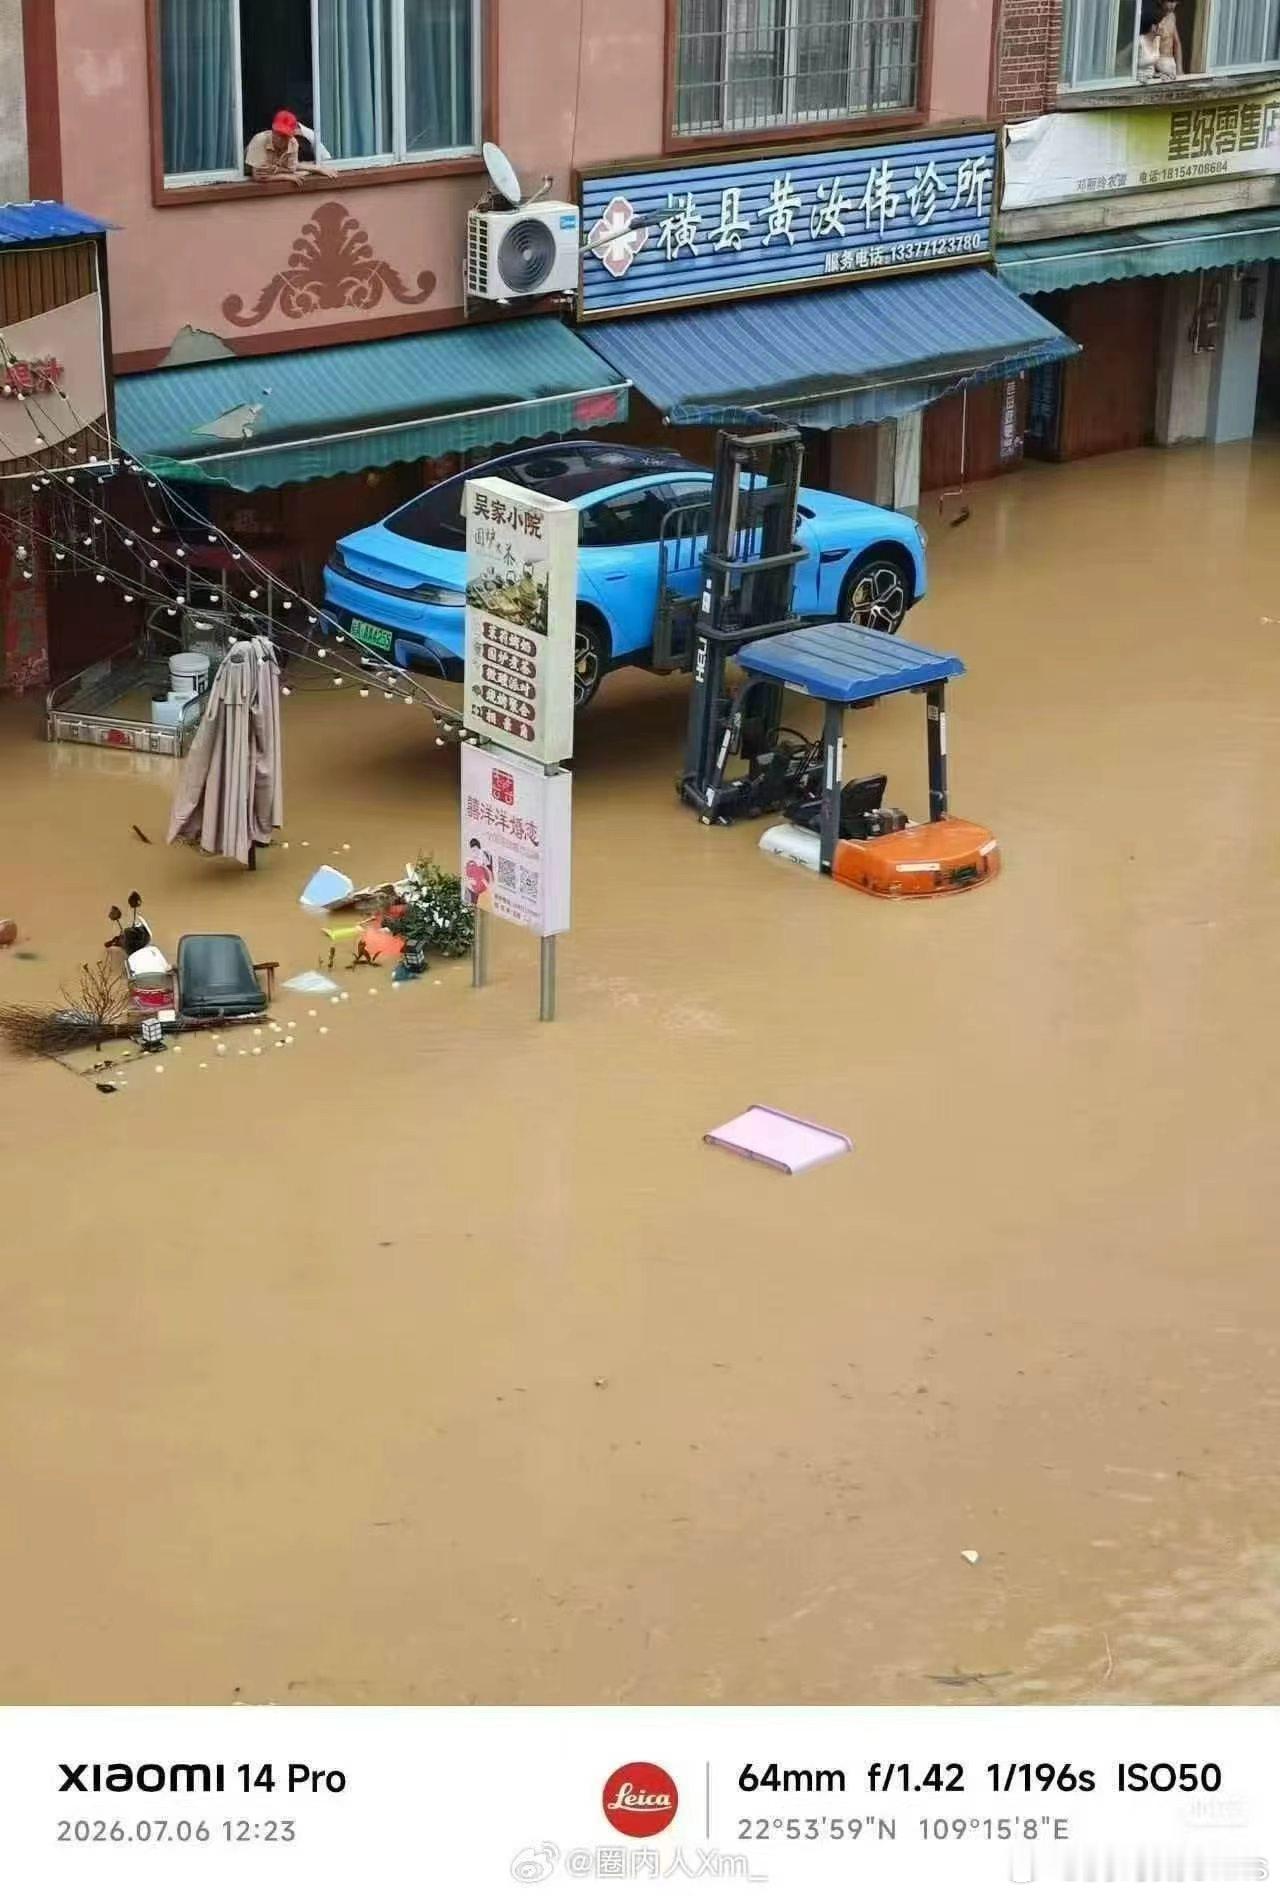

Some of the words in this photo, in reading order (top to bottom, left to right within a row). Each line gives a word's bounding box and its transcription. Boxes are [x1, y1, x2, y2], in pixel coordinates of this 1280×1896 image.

[656, 154, 993, 262] 横县黄汝伟诊所
[472, 492, 544, 540] 吴家小院
